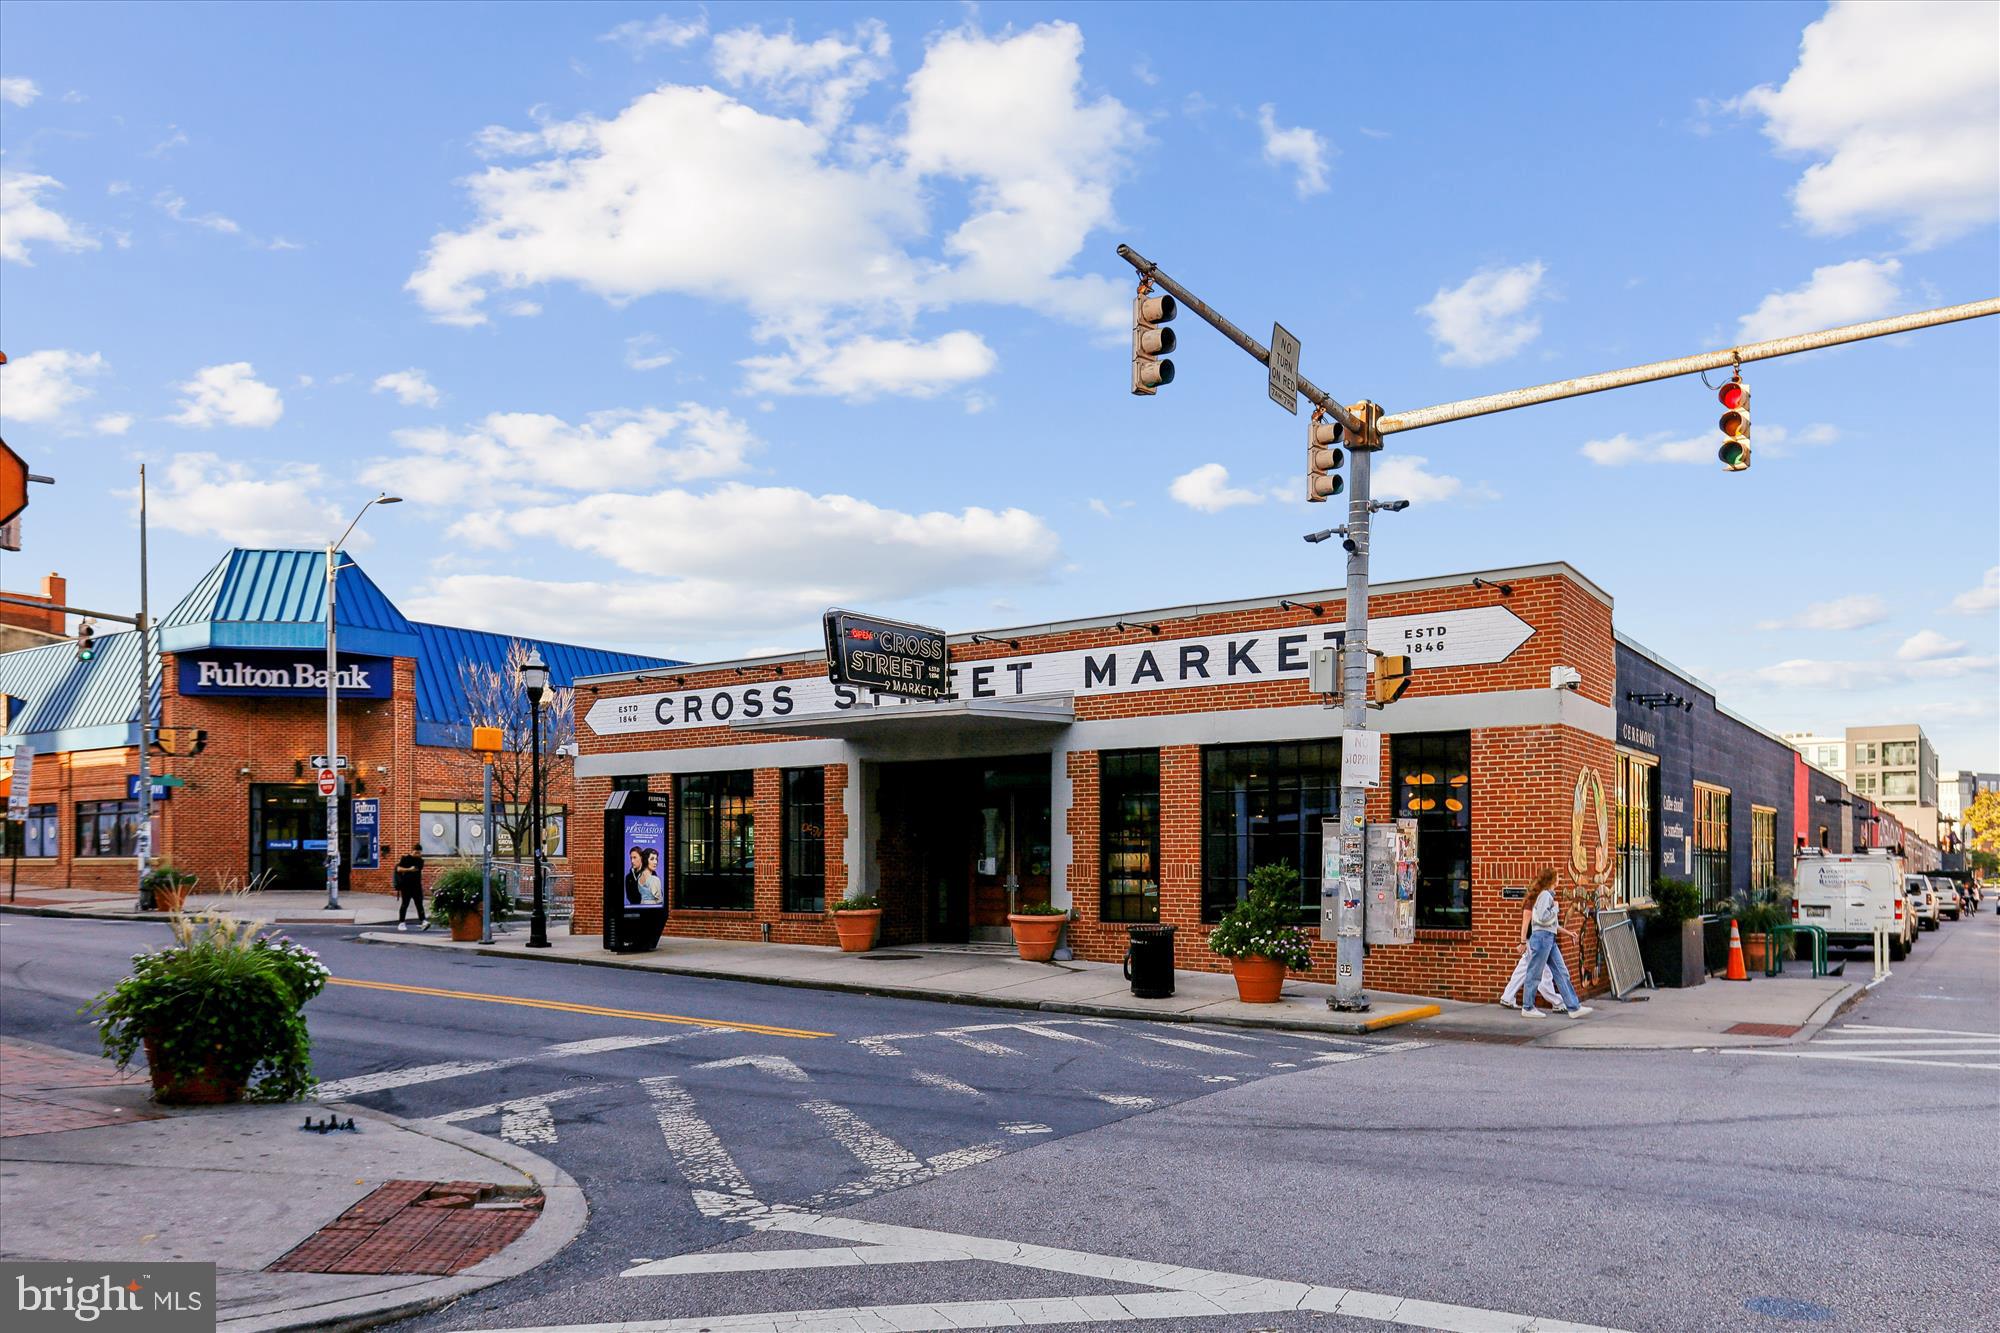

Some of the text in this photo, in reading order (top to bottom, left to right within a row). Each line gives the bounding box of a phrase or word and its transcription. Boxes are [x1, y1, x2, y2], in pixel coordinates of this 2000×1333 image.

[1280, 337, 1293, 354] NO
[1276, 352, 1293, 374] TURN
[1271, 366, 1296, 393] ON RED
[1404, 626, 1447, 640] ESTD
[880, 630, 943, 660] CROSS
[1406, 641, 1445, 654] 1846
[851, 650, 925, 680] STREET
[197, 661, 371, 689] Fulton Bank
[892, 681, 932, 696] MARKET
[618, 704, 639, 714] ESTD
[655, 685, 794, 725] CROSS
[619, 715, 638, 723] 1846
[1622, 723, 1656, 749] CEREMONY
[354, 801, 377, 813] Fulton
[356, 813, 375, 824] Bank
[625, 826, 665, 834] PERSUASION
[1340, 964, 1351, 974] 3E
